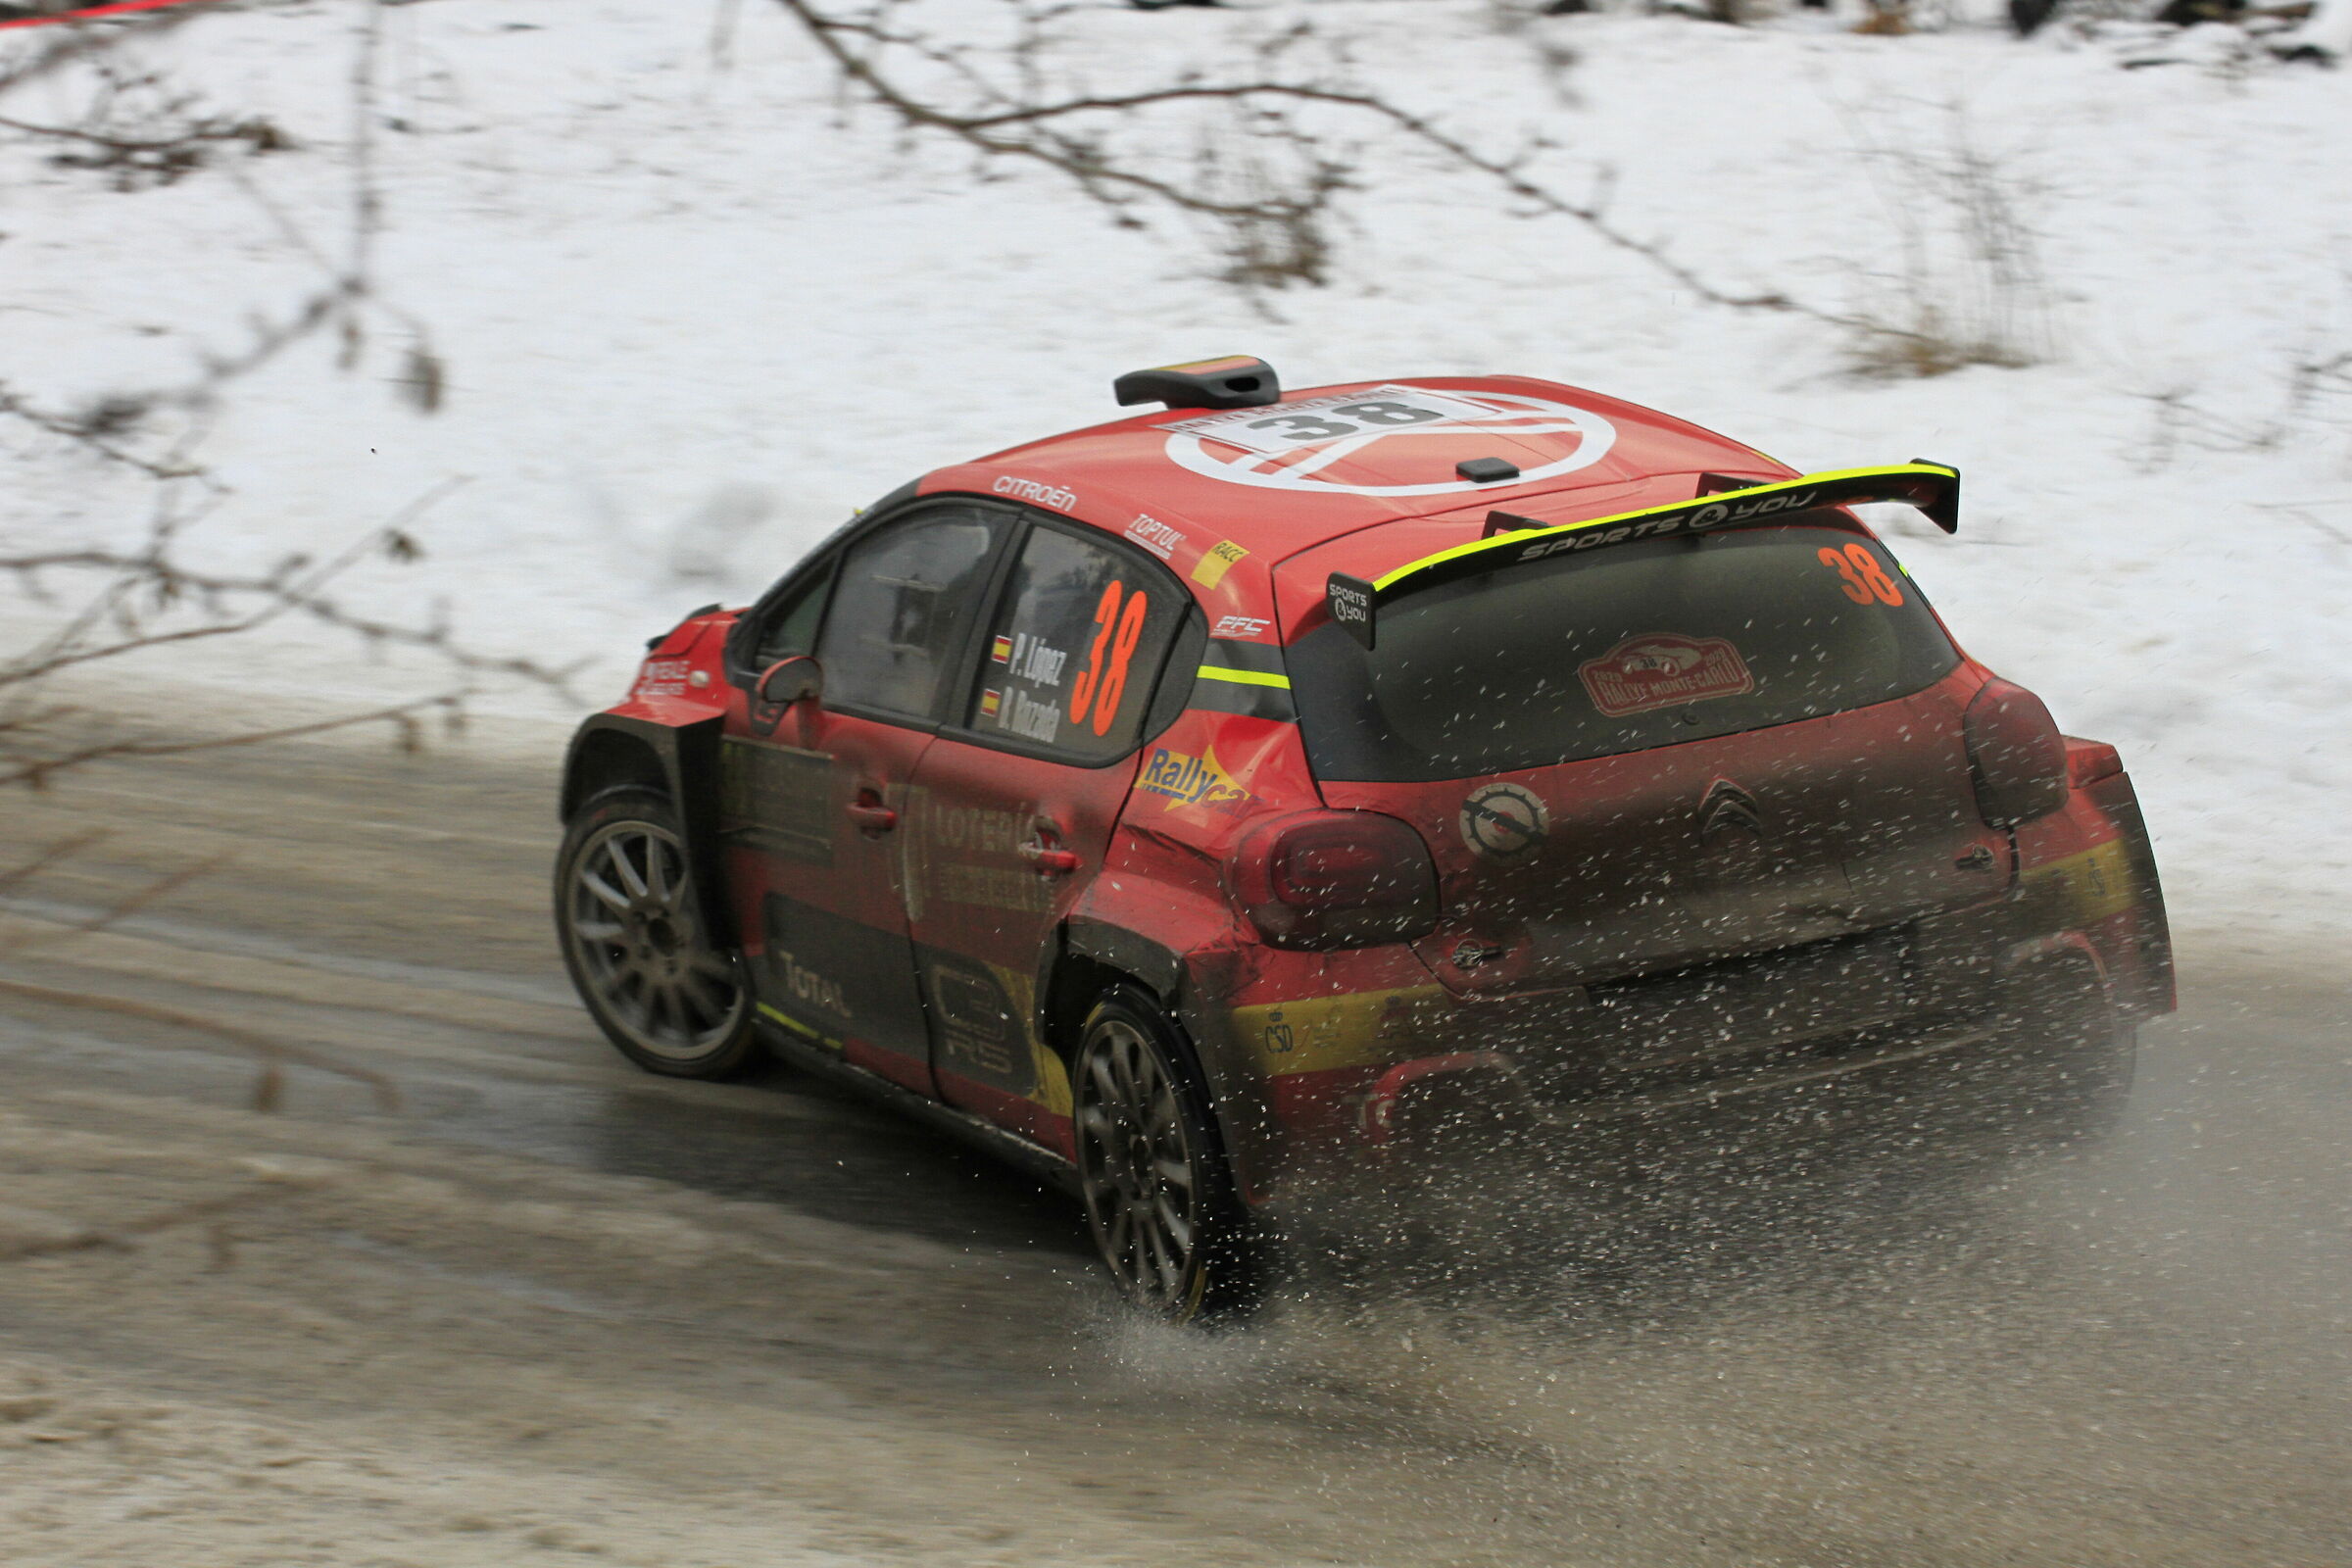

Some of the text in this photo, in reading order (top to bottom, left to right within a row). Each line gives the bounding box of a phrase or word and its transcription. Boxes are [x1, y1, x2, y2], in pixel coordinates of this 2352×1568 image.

[1245, 401, 1446, 441] 38
[1129, 513, 1180, 551] TOPTUL
[1517, 491, 1816, 562] SPORTS YOU
[1214, 542, 1245, 563] RACC
[1817, 542, 1904, 607] 38
[1329, 583, 1367, 607] SPORTS
[1346, 605, 1366, 622] YOU
[1009, 632, 1068, 689] P. López
[1069, 579, 1148, 737] 38
[1595, 680, 1647, 707] RALLYE
[777, 949, 854, 1018] TOTAL
[1264, 1022, 1295, 1054] CSD
